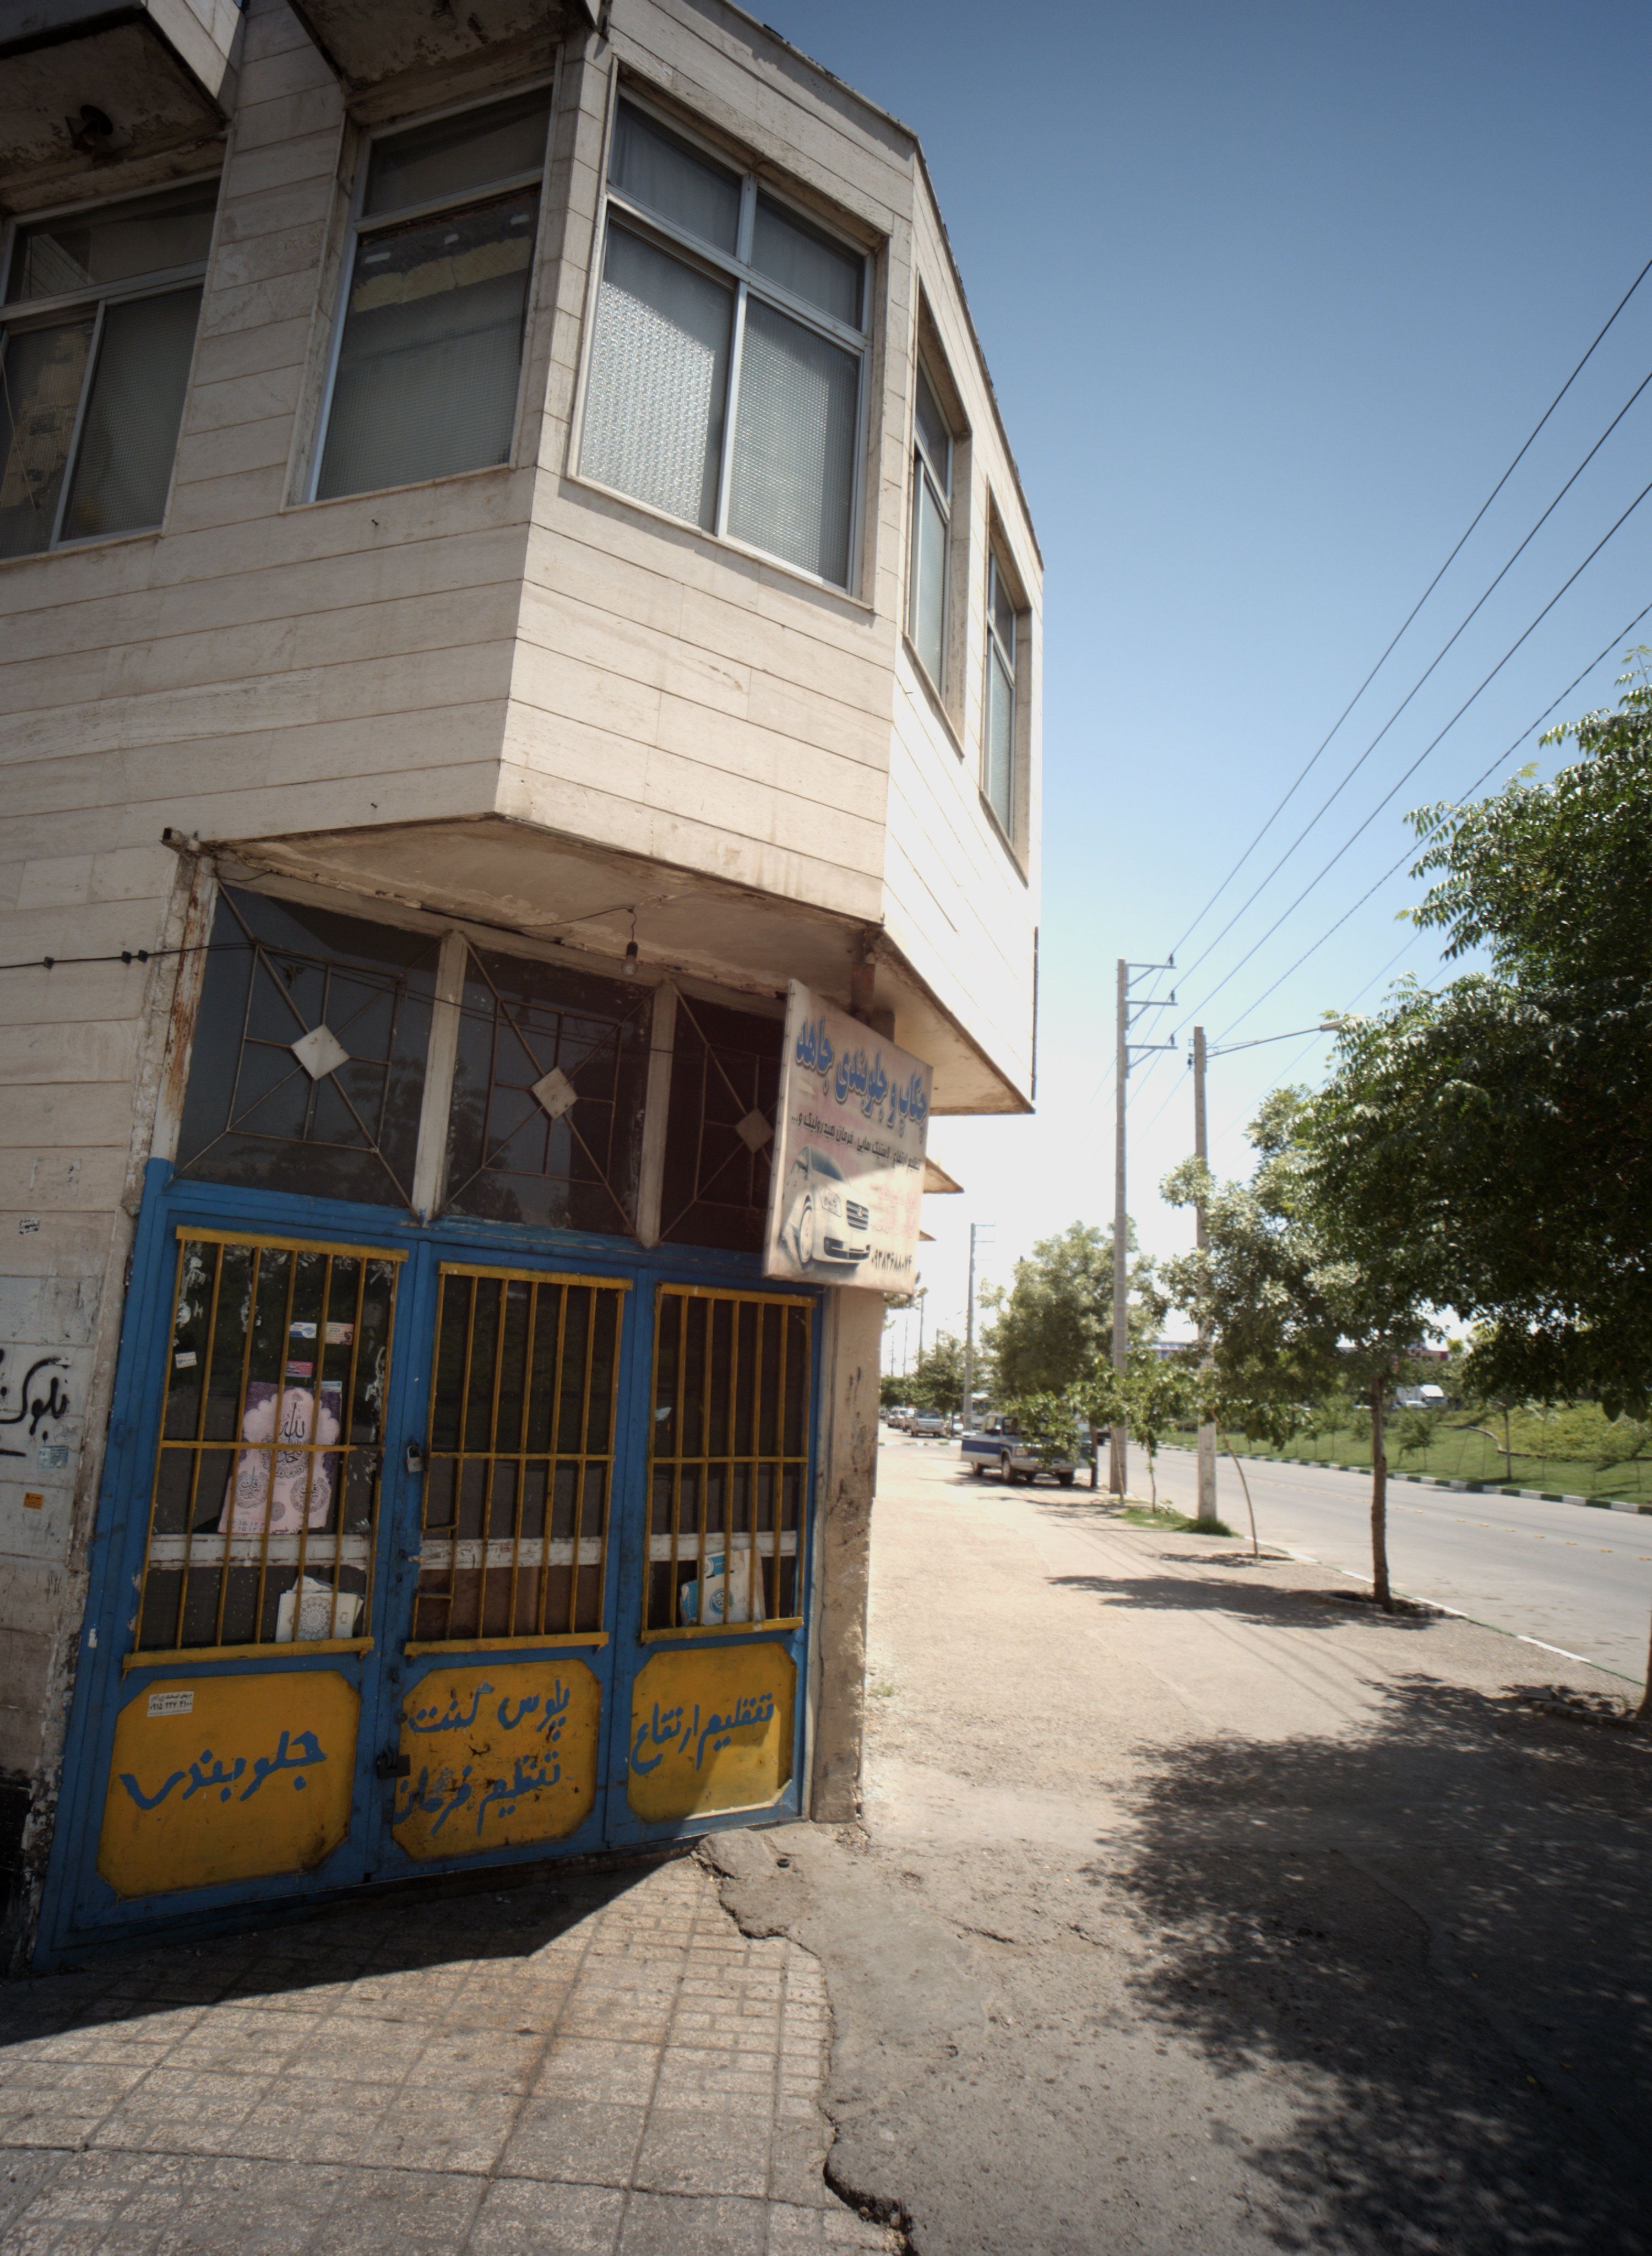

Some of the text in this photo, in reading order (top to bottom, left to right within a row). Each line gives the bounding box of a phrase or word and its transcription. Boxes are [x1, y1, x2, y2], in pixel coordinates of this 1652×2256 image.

[796, 1015, 835, 1096] جاهد
[835, 1048, 888, 1122] جلوبندی
[804, 1111, 835, 1140] هیدرولیک
[836, 1125, 854, 1145] فرمان
[887, 1080, 897, 1128] و
[893, 1151, 908, 1169] ارتفاع
[907, 1157, 922, 1174] تنظیم
[498, 1679, 570, 1742] پلوس
[631, 1692, 774, 1776] تنظیم ارتفاع
[119, 1730, 328, 1810] جلوبندی
[392, 1750, 561, 1836] تنظیم فرمان
